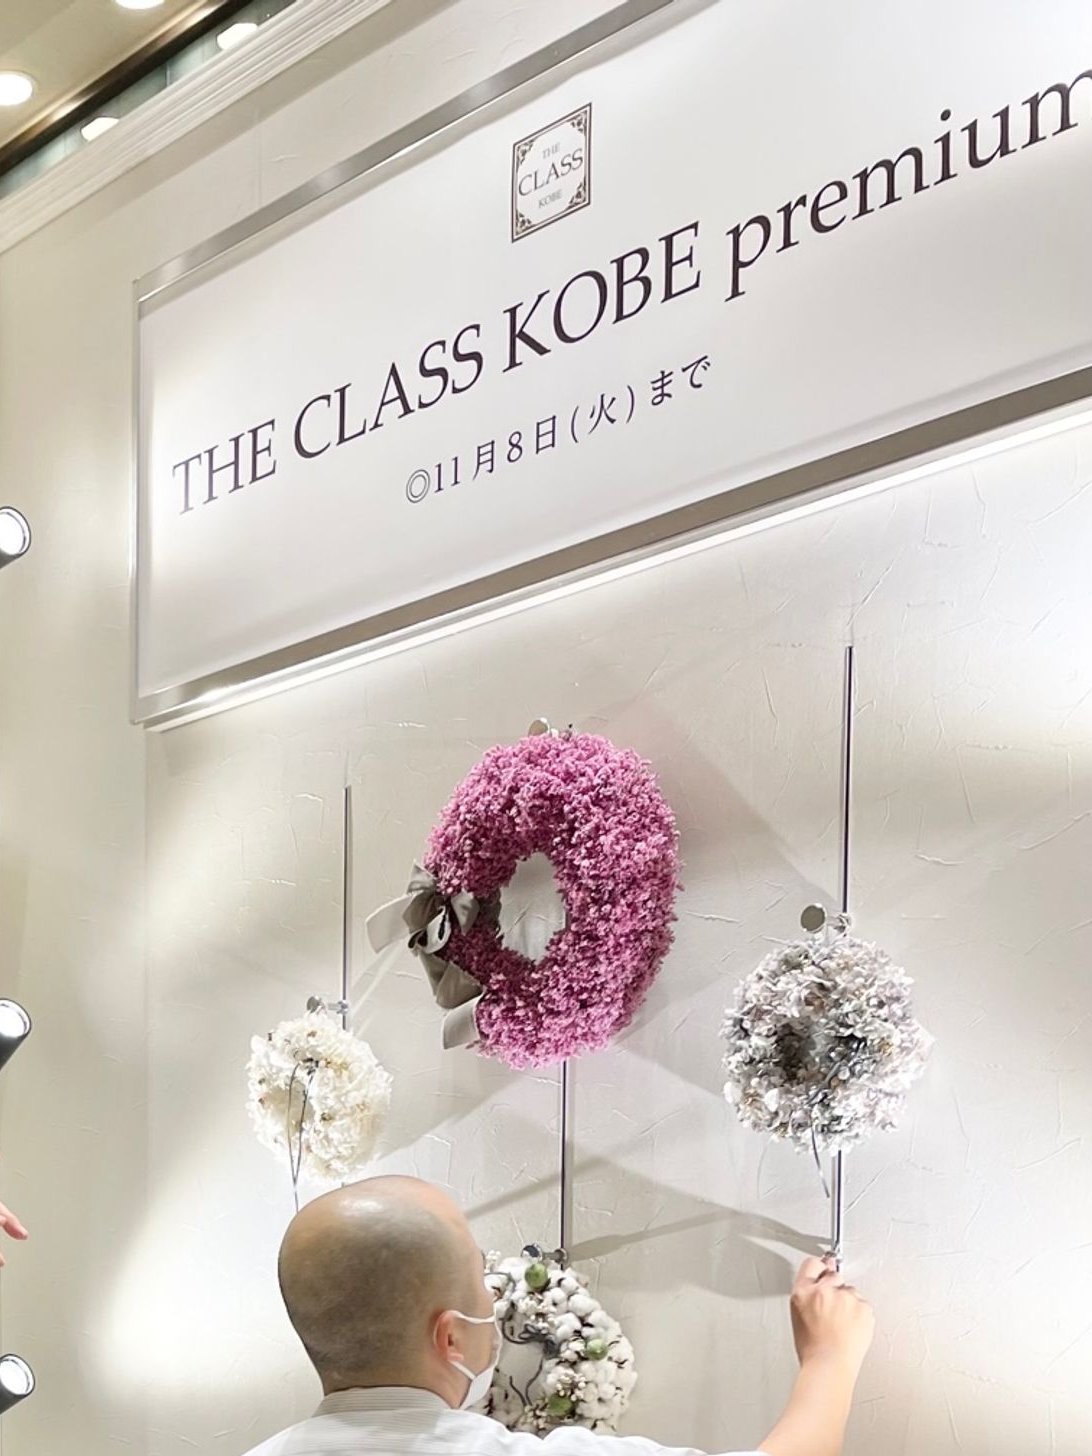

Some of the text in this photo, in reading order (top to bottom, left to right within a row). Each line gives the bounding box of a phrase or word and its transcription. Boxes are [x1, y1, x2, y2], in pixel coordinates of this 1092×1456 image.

[518, 148, 583, 196] CLASS
[172, 418, 277, 516] THE
[293, 323, 484, 460] CLASS
[502, 220, 701, 373] KOBE
